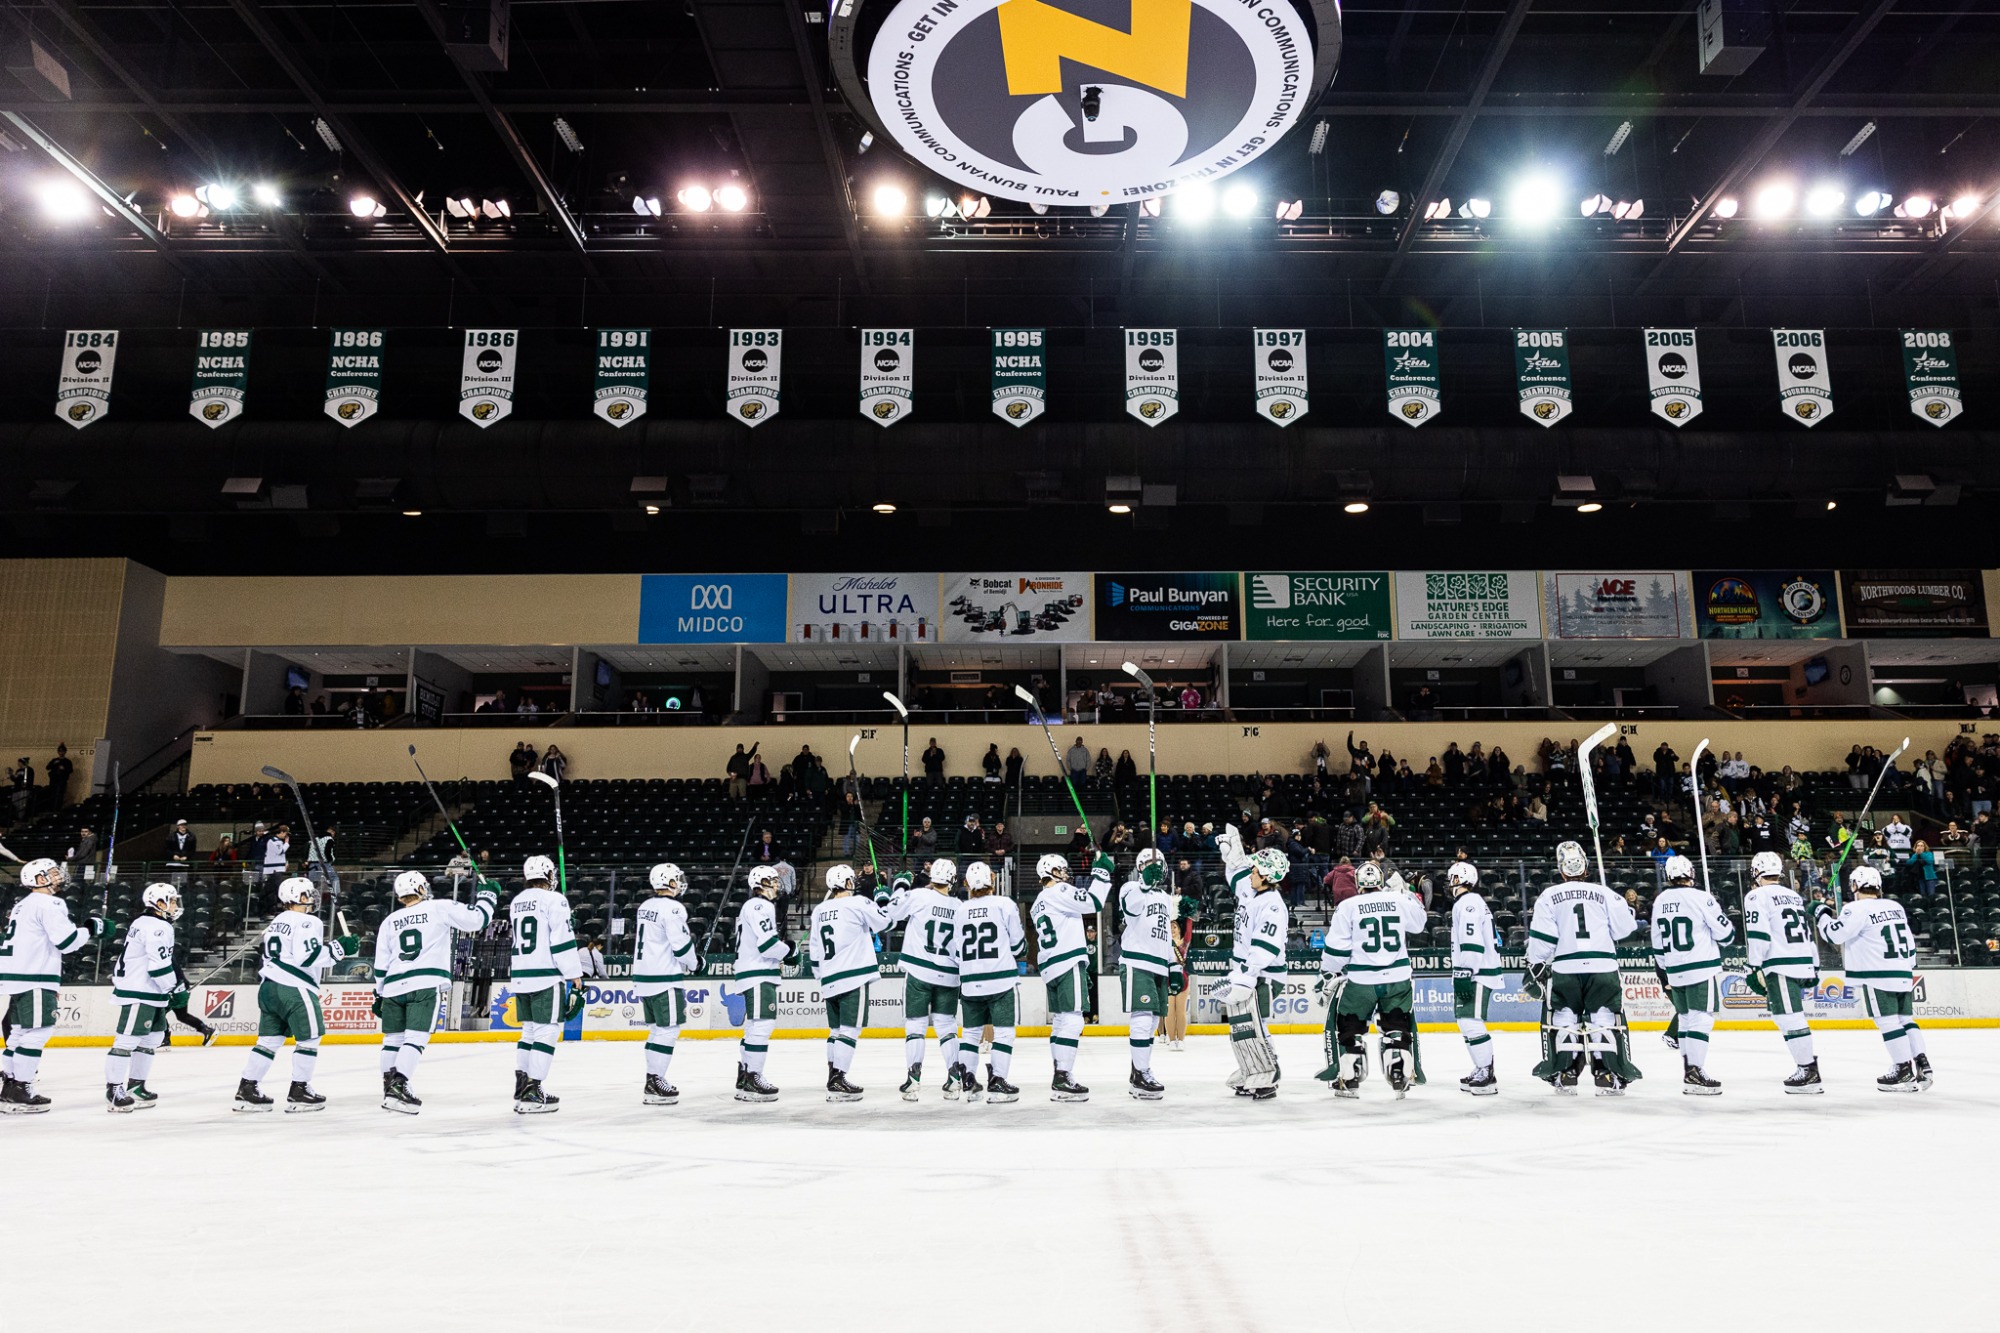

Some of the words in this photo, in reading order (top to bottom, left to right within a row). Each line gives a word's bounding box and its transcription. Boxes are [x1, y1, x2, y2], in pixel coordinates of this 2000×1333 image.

[932, 0, 958, 17] IN
[908, 14, 938, 42] GET
[1257, 8, 1300, 128] COMMUNICATIONS
[894, 51, 957, 161] COMMUNICATIONS
[1236, 136, 1266, 159] GET
[1215, 156, 1238, 170] IN
[956, 160, 1028, 191] BUNYAN
[1034, 185, 1079, 198] PAUL
[67, 333, 115, 348] 1984
[200, 332, 249, 348] 1985
[333, 331, 383, 348] 1986
[467, 332, 515, 347] 1986
[600, 332, 647, 347] 1991
[733, 332, 779, 347] 1993
[864, 331, 911, 346] 1994
[995, 331, 1042, 347] 1995
[1128, 331, 1174, 346] 1995
[1257, 332, 1303, 347] 1997
[1387, 331, 1434, 347] 2004
[1517, 332, 1563, 348] 2005
[1648, 332, 1694, 347] 2005
[1776, 332, 1822, 347] 2006
[1904, 332, 1951, 348] 2008
[77, 360, 101, 369] NCAA
[198, 356, 245, 369] NCHA
[331, 356, 380, 368] NCHA
[478, 360, 502, 368] NCAA
[599, 356, 646, 368] NCHA
[744, 359, 767, 367] NCAA
[876, 359, 899, 367] NCAA
[995, 356, 1042, 368] NCHA
[1141, 359, 1163, 367] NCAA
[1271, 359, 1293, 367] NCAA
[1661, 365, 1687, 374] NCAA
[1791, 365, 1818, 374] NCAA
[58, 387, 109, 400] CHAMPIONS
[192, 386, 243, 400] CHAMPIONS
[326, 386, 378, 399] CHAMPIONS
[461, 387, 512, 399] CHAMPIONS
[595, 386, 646, 399] CHAMPIONS
[728, 386, 778, 399] CHAMPIONS
[861, 386, 911, 398] CHAMPIONS
[993, 386, 1044, 399] CHAMPIONS
[1127, 386, 1177, 398] CHAMPIONS
[1257, 386, 1307, 398] CHAMPIONS
[1388, 386, 1438, 399] CHAMPIONS
[1519, 386, 1570, 399] CHAMPIONS
[1651, 386, 1700, 398] TOURNAMENT
[1781, 386, 1830, 398] TOURNAMENT
[1910, 386, 1959, 399] CHAMPIONS
[833, 577, 899, 591] Michelob
[983, 579, 1011, 588] Bobcat
[1294, 578, 1381, 591] SECURITY
[1596, 578, 1636, 595] ACE
[1785, 583, 1803, 595] WHITE
[1805, 584, 1816, 595] OAK
[1130, 587, 1163, 603] Paul
[1168, 588, 1228, 606] Bunyan
[1295, 592, 1346, 605] BANK
[1860, 586, 1916, 601] NORTHWOODS
[1918, 586, 1950, 597] LUMBER
[1951, 586, 1966, 600] CO.
[819, 594, 915, 614] ULTRA
[1428, 602, 1479, 611] NATURE'S
[1483, 602, 1509, 611] EDGE
[1739, 607, 1758, 615] LIGHTS
[1793, 608, 1816, 616] CASINO
[678, 617, 743, 632] MIDCO
[1267, 616, 1300, 627] Here
[1551, 889, 1605, 906] HILDEBRAND
[968, 907, 989, 920] PEER
[1358, 901, 1396, 915] ROBBINS
[393, 913, 429, 931] PANZER
[1573, 903, 1590, 939] 1
[1745, 910, 1759, 924] 28
[759, 918, 774, 933] 27
[1260, 921, 1278, 937] 30
[1466, 923, 1475, 936] 5
[512, 916, 538, 956] 19
[924, 919, 954, 957] 17
[1359, 915, 1402, 953] 35
[1657, 916, 1695, 953] 20
[1880, 923, 1910, 959] 15
[303, 937, 320, 952] 18
[398, 928, 423, 961] 9
[820, 924, 836, 960] 6
[962, 922, 999, 961] 22
[779, 991, 805, 1003] LUE
[1625, 987, 1660, 1000] CHER
[323, 1009, 376, 1021] SONRY
[1326, 1029, 1335, 1066] VAUGHN
